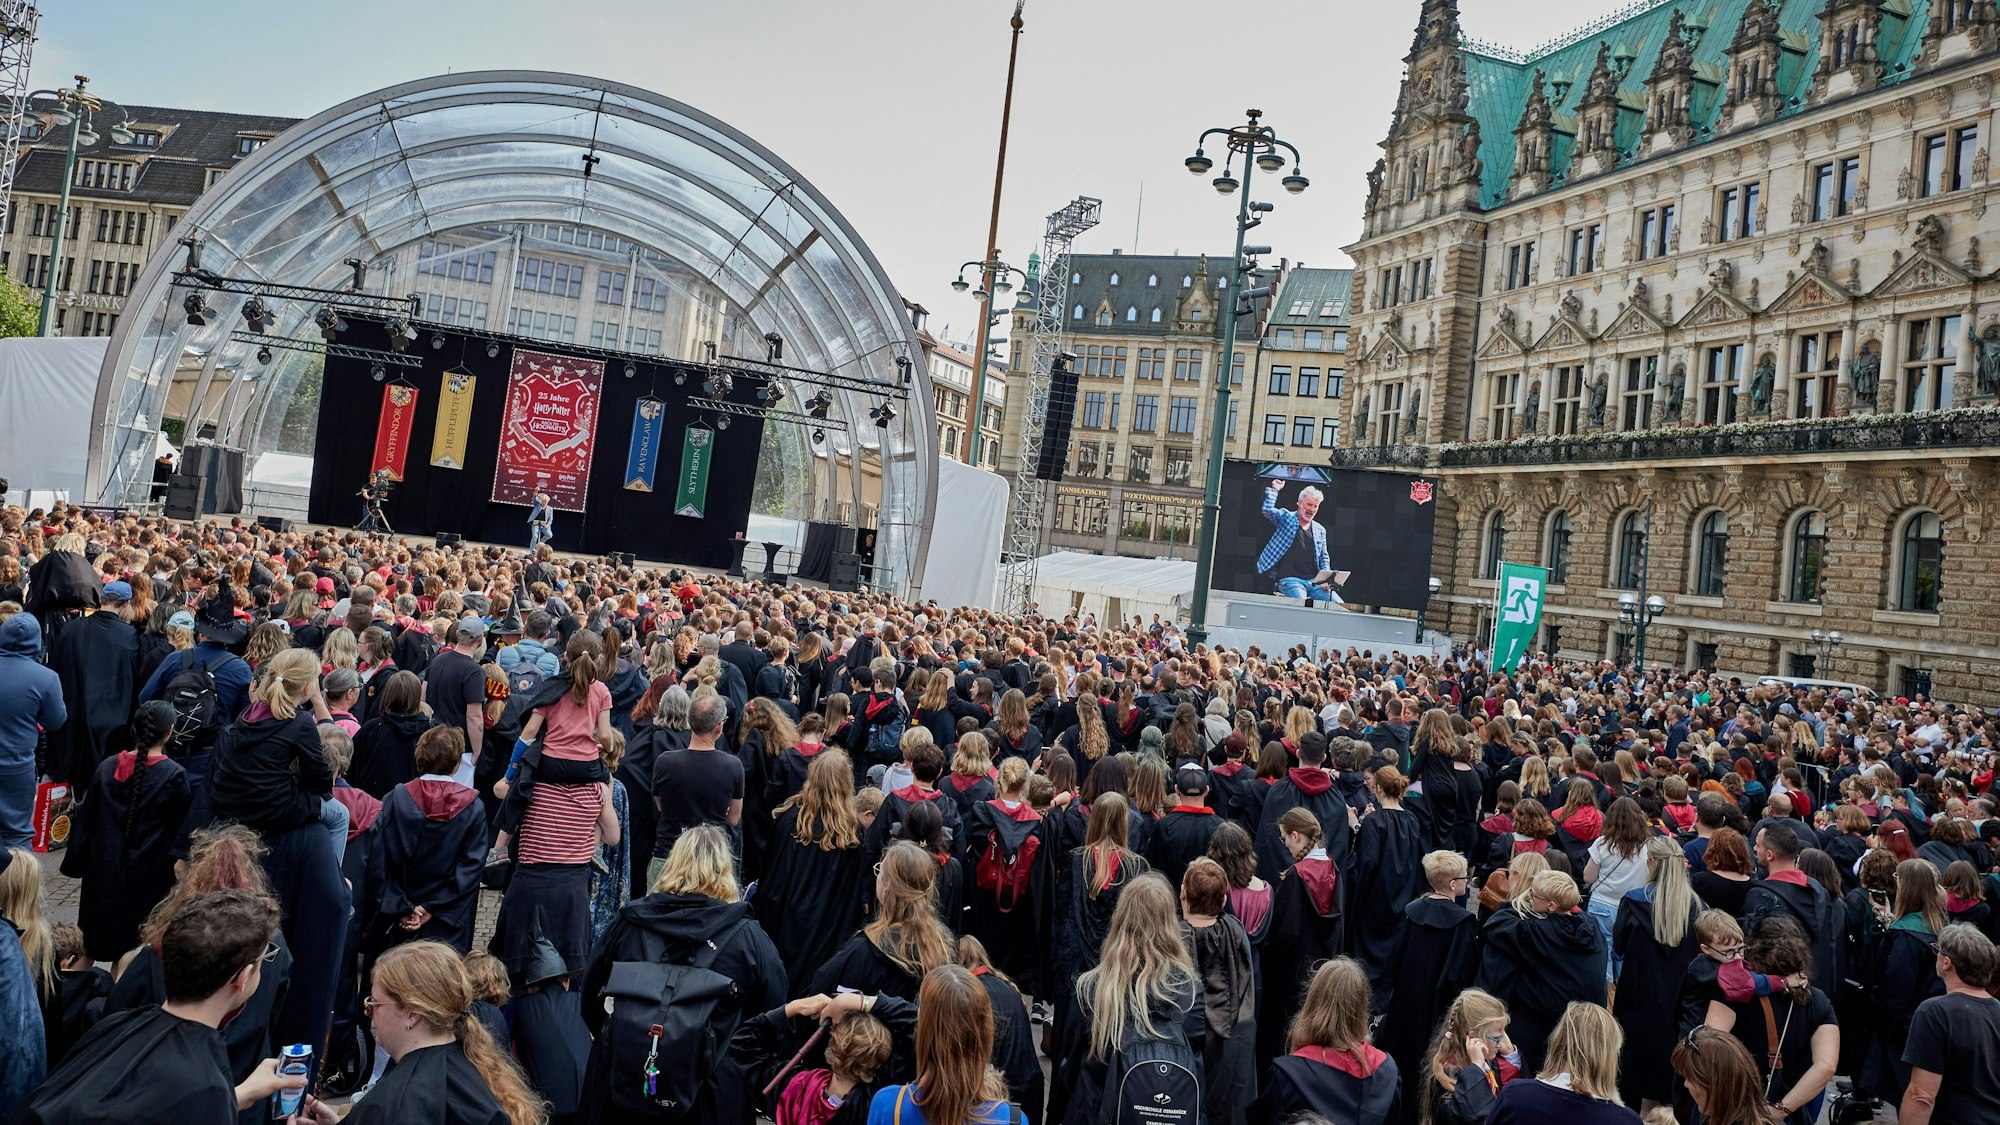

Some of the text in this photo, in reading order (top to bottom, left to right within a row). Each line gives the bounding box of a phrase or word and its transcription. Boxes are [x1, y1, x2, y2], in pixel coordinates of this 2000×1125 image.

[81, 294, 122, 310] BANK
[537, 392, 570, 402] 25 Jahre
[533, 402, 571, 417] Harry Potter
[445, 395, 460, 449] HUFFLEPUFF
[533, 422, 567, 433] HOGWARTS
[385, 407, 402, 463] GRYFFINDOR
[638, 421, 652, 473] RAVENCLAW
[688, 448, 701, 495] SLYTHERIN
[1058, 486, 1108, 496] HANSEATISCHE
[1133, 1105, 1162, 1113] HOCHSCHULE
